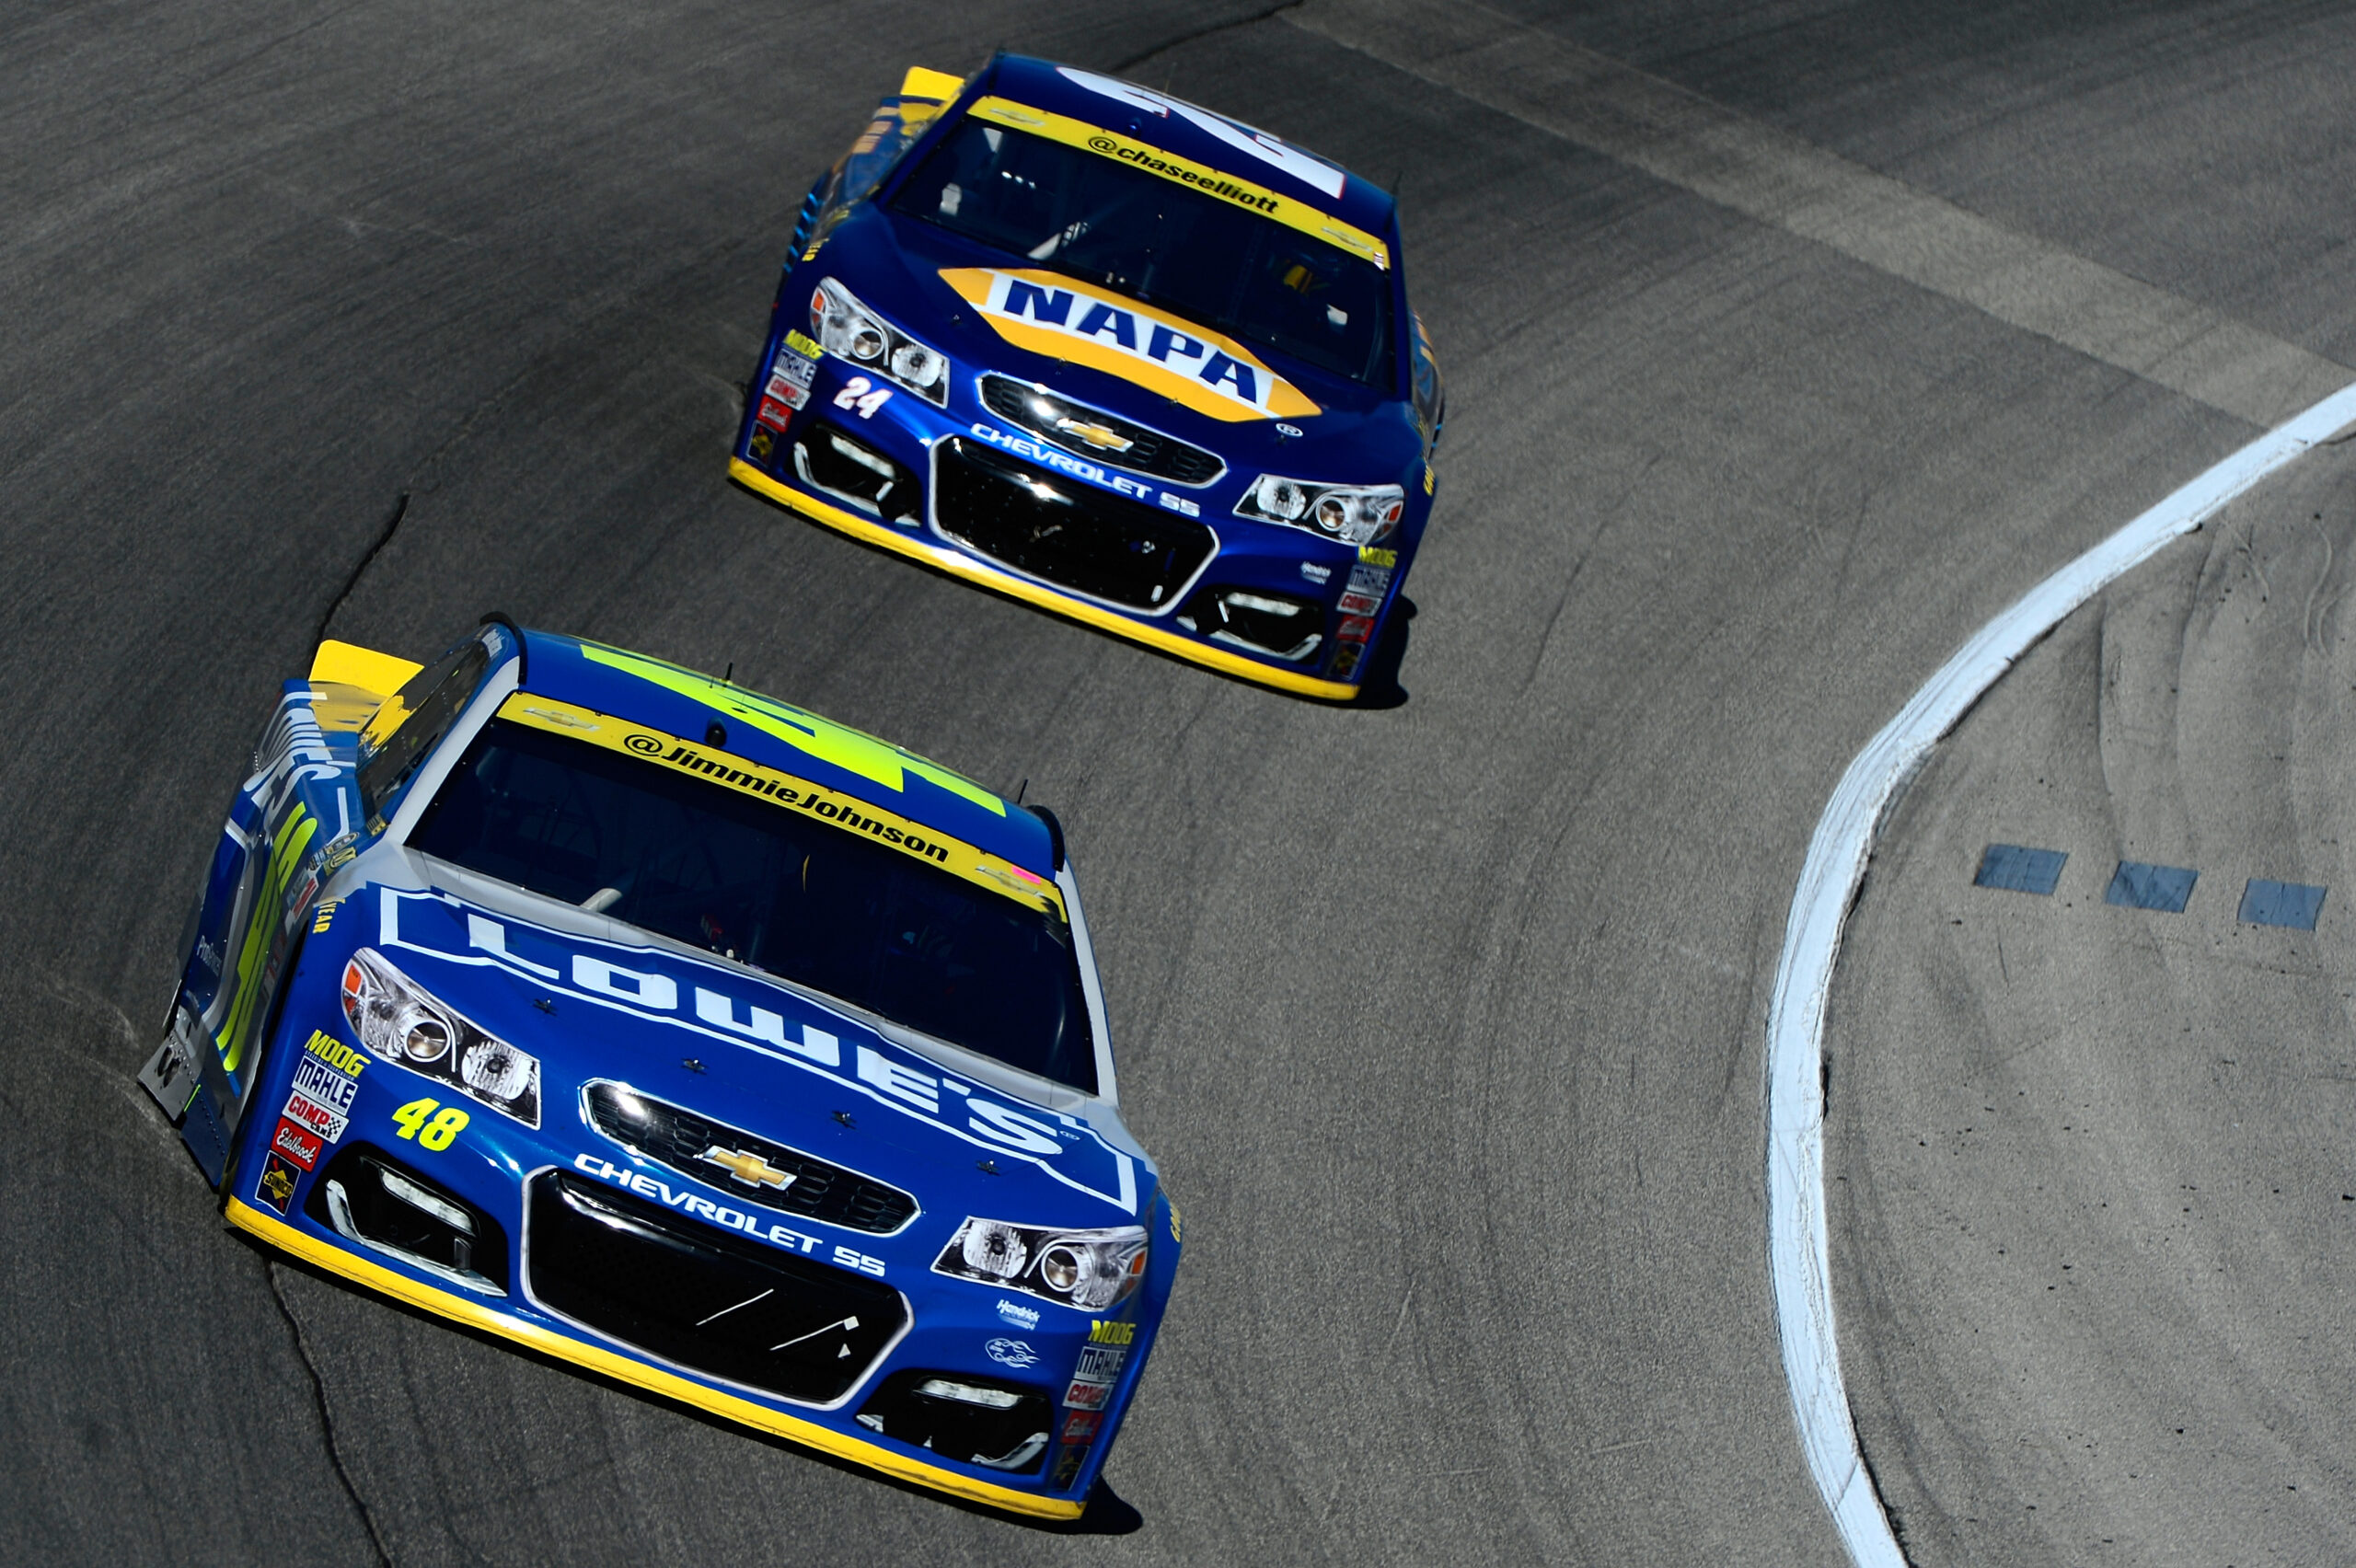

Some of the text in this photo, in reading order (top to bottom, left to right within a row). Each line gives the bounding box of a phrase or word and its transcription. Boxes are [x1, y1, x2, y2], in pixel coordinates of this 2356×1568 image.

[1088, 135, 1280, 214] @chaseelliott
[1003, 279, 1258, 404] NAPA
[833, 376, 895, 420] 24
[970, 422, 1202, 518] CHEVROLET SS
[623, 733, 950, 863] @JimmieJohnson
[304, 1029, 372, 1078] MOOG
[468, 913, 1065, 1158] LOWE'S
[288, 1095, 331, 1126] COMP
[295, 1057, 357, 1110] MAHLE
[276, 1127, 318, 1164] Edelbrock
[310, 1122, 333, 1139] CAMS
[391, 1097, 470, 1152] 48
[574, 1153, 886, 1277] CHEVROLET SS
[1088, 1319, 1137, 1345] MOOG
